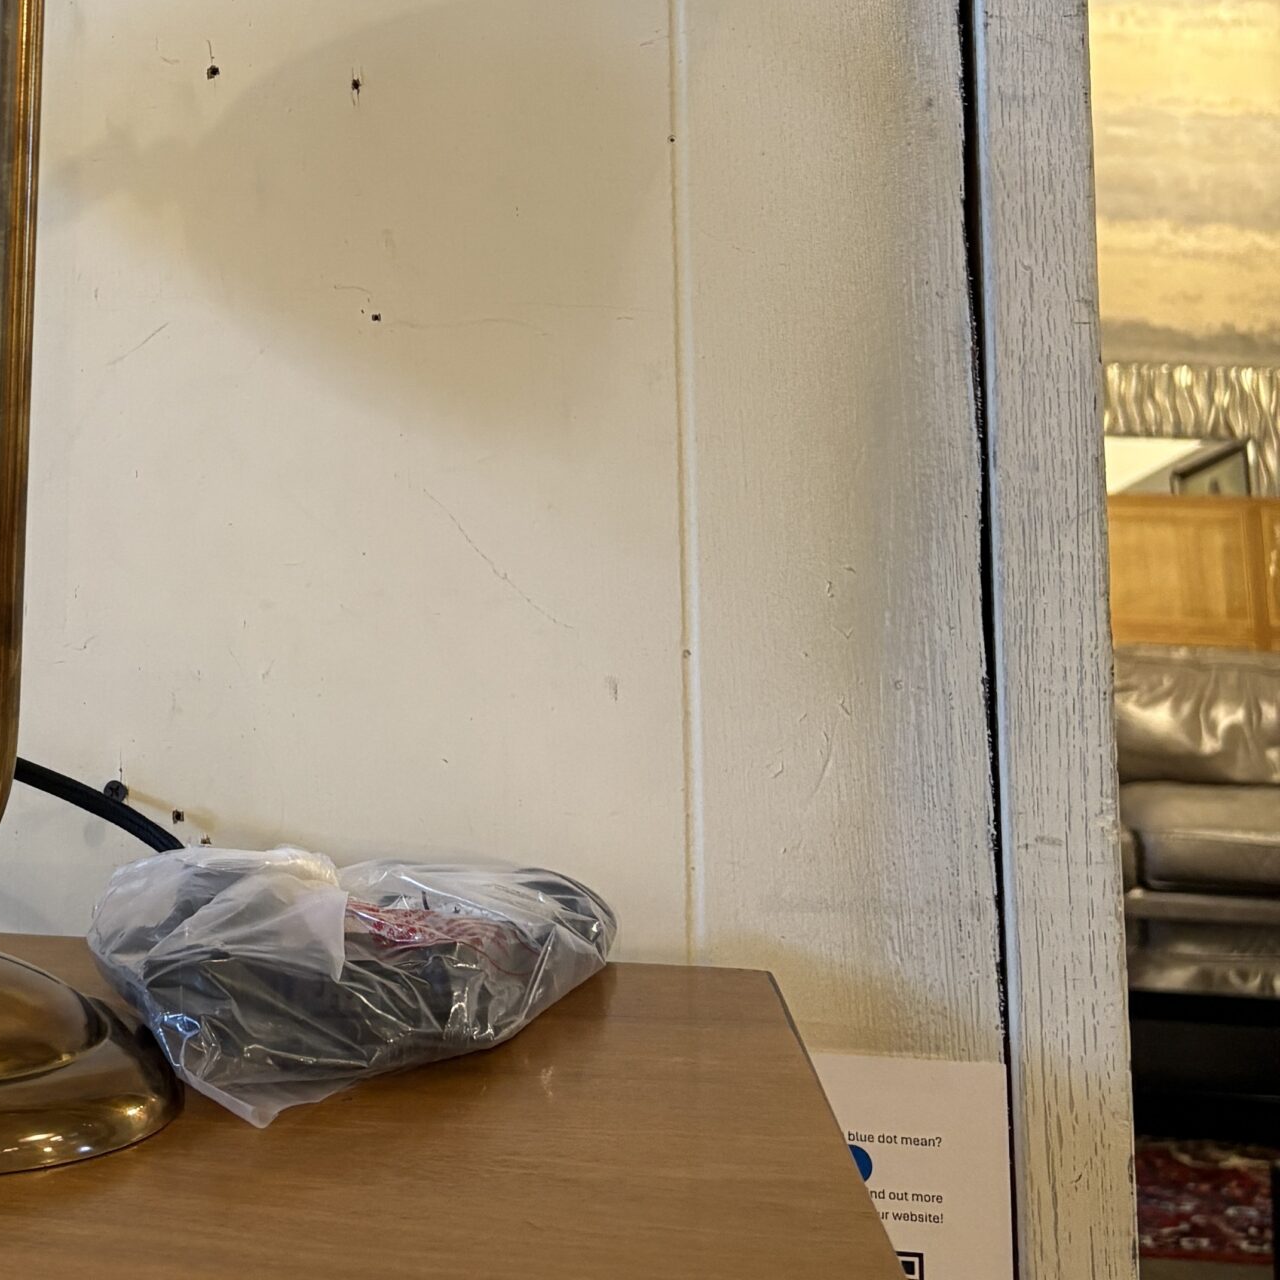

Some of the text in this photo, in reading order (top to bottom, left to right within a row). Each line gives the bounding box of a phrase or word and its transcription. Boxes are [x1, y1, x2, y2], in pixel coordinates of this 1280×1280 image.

[847, 1131, 942, 1147] blue dot mean?
[888, 1191, 909, 1201] out
[911, 1193, 943, 1203] more
[892, 1211, 944, 1224] website!
